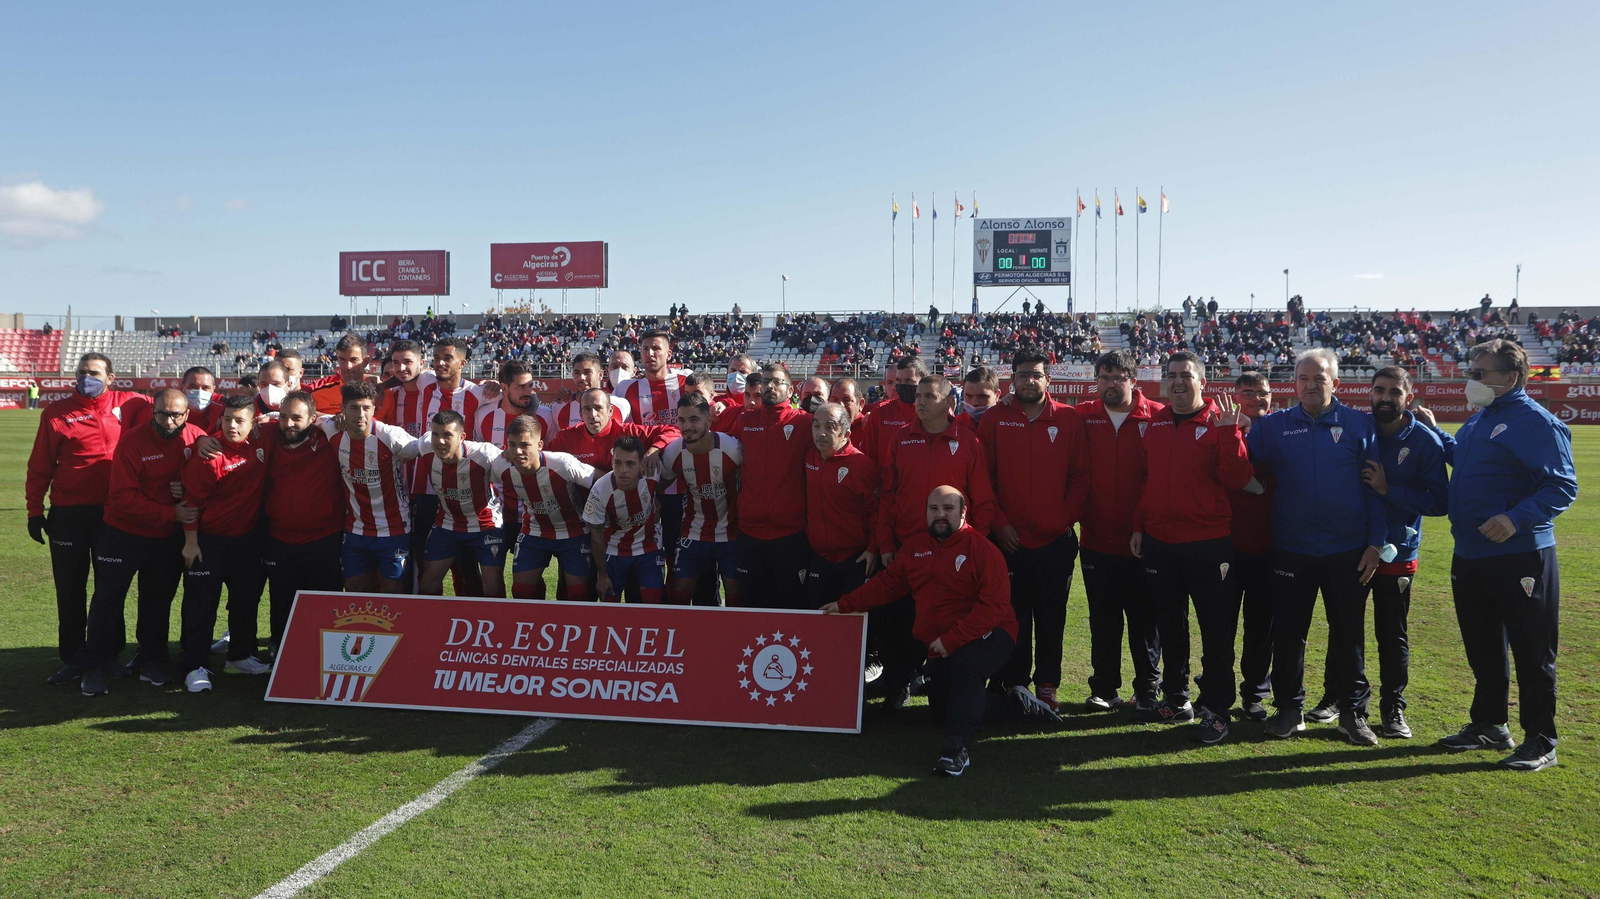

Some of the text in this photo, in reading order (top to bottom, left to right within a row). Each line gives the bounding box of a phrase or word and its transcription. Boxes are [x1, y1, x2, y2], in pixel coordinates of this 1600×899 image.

[980, 219, 1064, 230] Alonso Alonso
[523, 260, 559, 269] Algeciras
[999, 257, 1013, 269] 00
[1031, 257, 1046, 269] 00
[352, 260, 386, 282] ICC
[1428, 402, 1466, 414] Hospital
[999, 420, 1025, 428] GIVOVA
[1282, 428, 1308, 436] GIVOVA
[142, 454, 165, 462] GIVOVA
[98, 555, 123, 563] GIVOVA
[445, 617, 685, 658] DR. ESPINEL
[439, 648, 684, 675] CLÍNICAS DENTALES ESPECIALIZADAS
[328, 663, 362, 673] ALGECIRAS
[433, 669, 680, 703] TU MEJOR SONRISA
